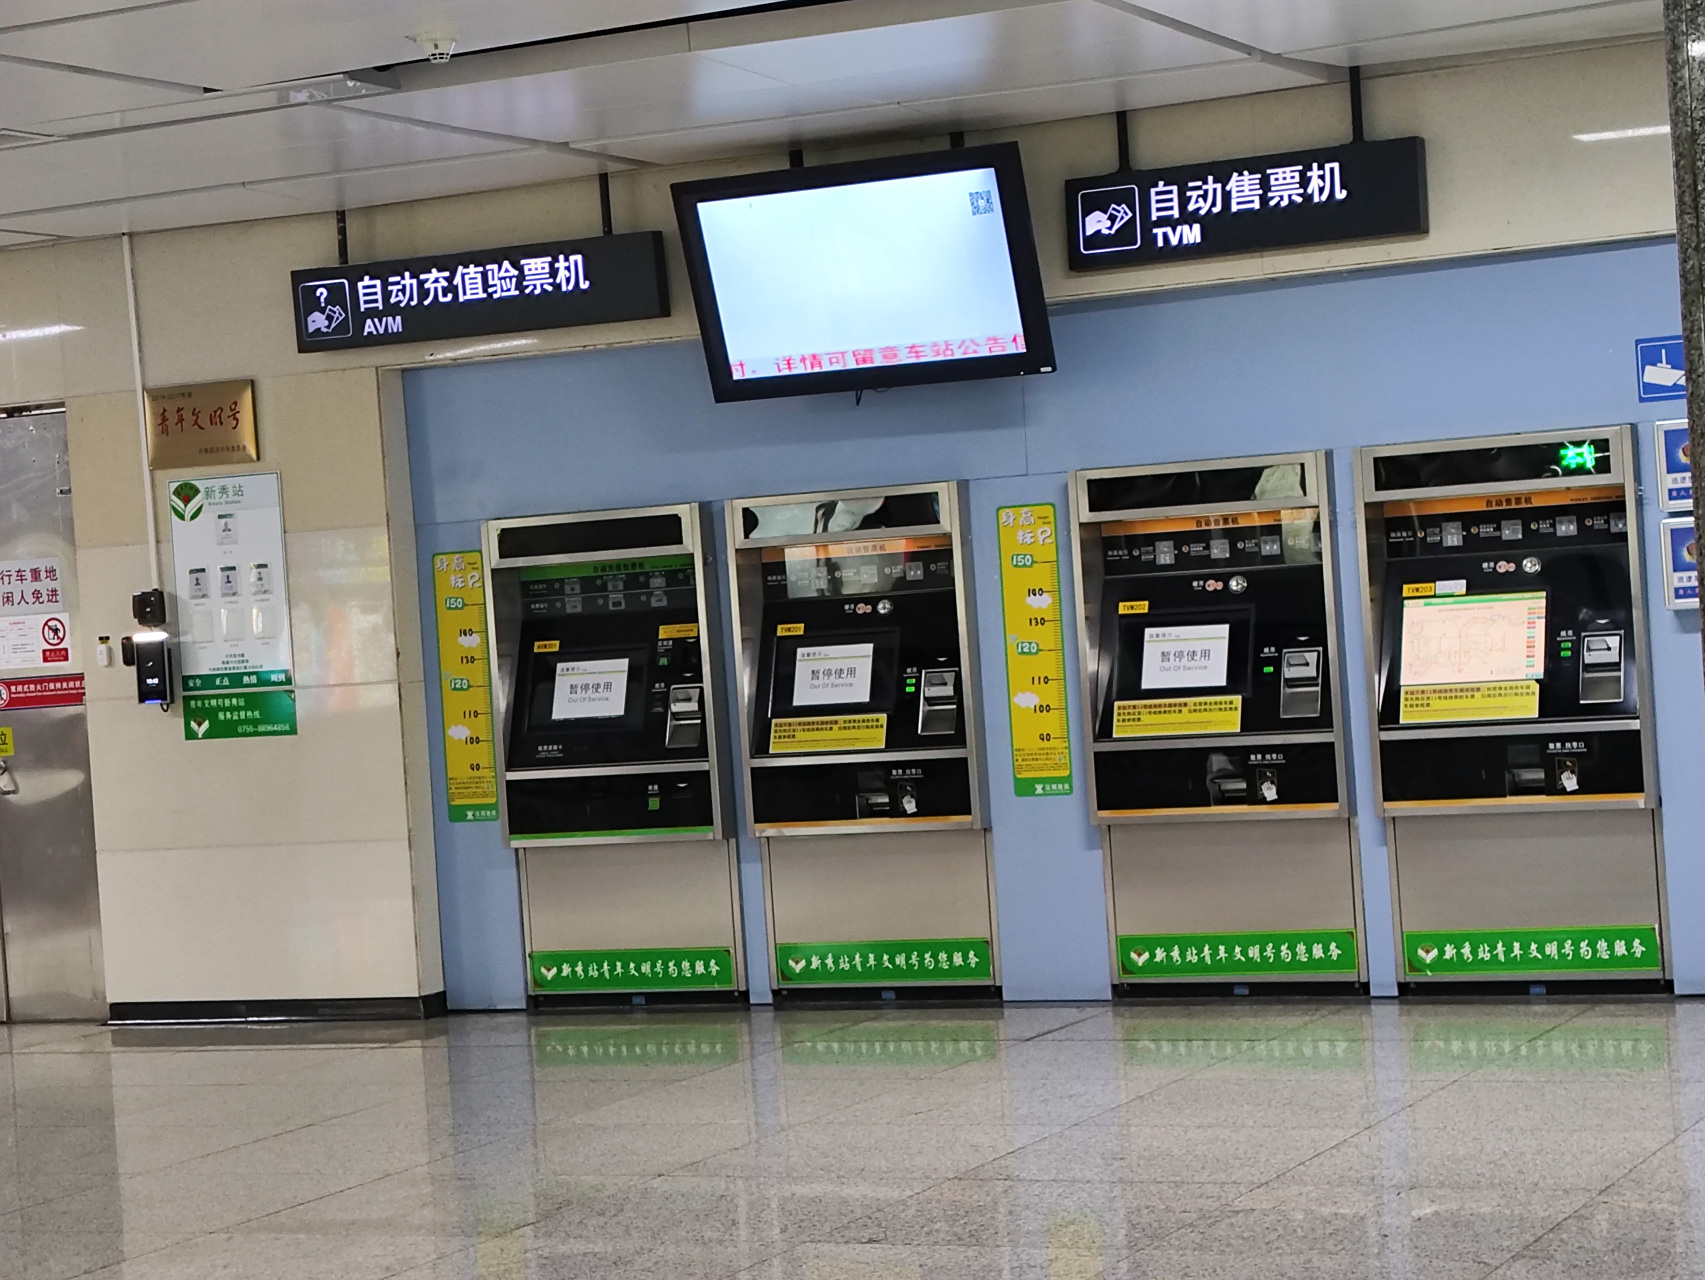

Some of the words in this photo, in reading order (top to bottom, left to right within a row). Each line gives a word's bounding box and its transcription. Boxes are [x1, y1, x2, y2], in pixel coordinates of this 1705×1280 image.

[1149, 161, 1347, 221] 自动售票机
[1152, 223, 1201, 248] TVM
[356, 253, 590, 312] 自动充值验票机
[363, 315, 403, 337] AVM
[158, 400, 241, 436] 青年文明号
[203, 483, 244, 500] 新秀站
[1001, 508, 1035, 527] 身高
[436, 554, 466, 572] 身高
[1012, 555, 1032, 566] 150
[0, 565, 58, 585] 行车重地
[1027, 588, 1044, 597] 140
[1407, 585, 1433, 594] TVM203
[1, 587, 60, 607] 闲人免进
[446, 598, 463, 608] 150
[1122, 603, 1147, 611] TVM202
[1029, 617, 1046, 627] 130
[459, 628, 474, 637] 140
[1017, 642, 1038, 653] 120
[460, 655, 475, 664] 130
[1160, 649, 1211, 663] 暂停使用
[811, 667, 857, 681] 暂停使用
[215, 677, 230, 686] 正点
[451, 679, 468, 688] 120
[1031, 676, 1049, 685] 110
[463, 710, 479, 719] 110
[1033, 704, 1051, 714] 100
[465, 736, 480, 745] 100
[1038, 733, 1051, 742] 90
[469, 763, 481, 771] 90
[1153, 941, 1342, 965] 新秀站青年文明号为您服务
[1442, 938, 1647, 963] 新秀站青年文明号为您服务
[809, 950, 980, 972] 新秀站青年文明号为您服务
[560, 958, 721, 979] 新秀站青年文明号为您服务
